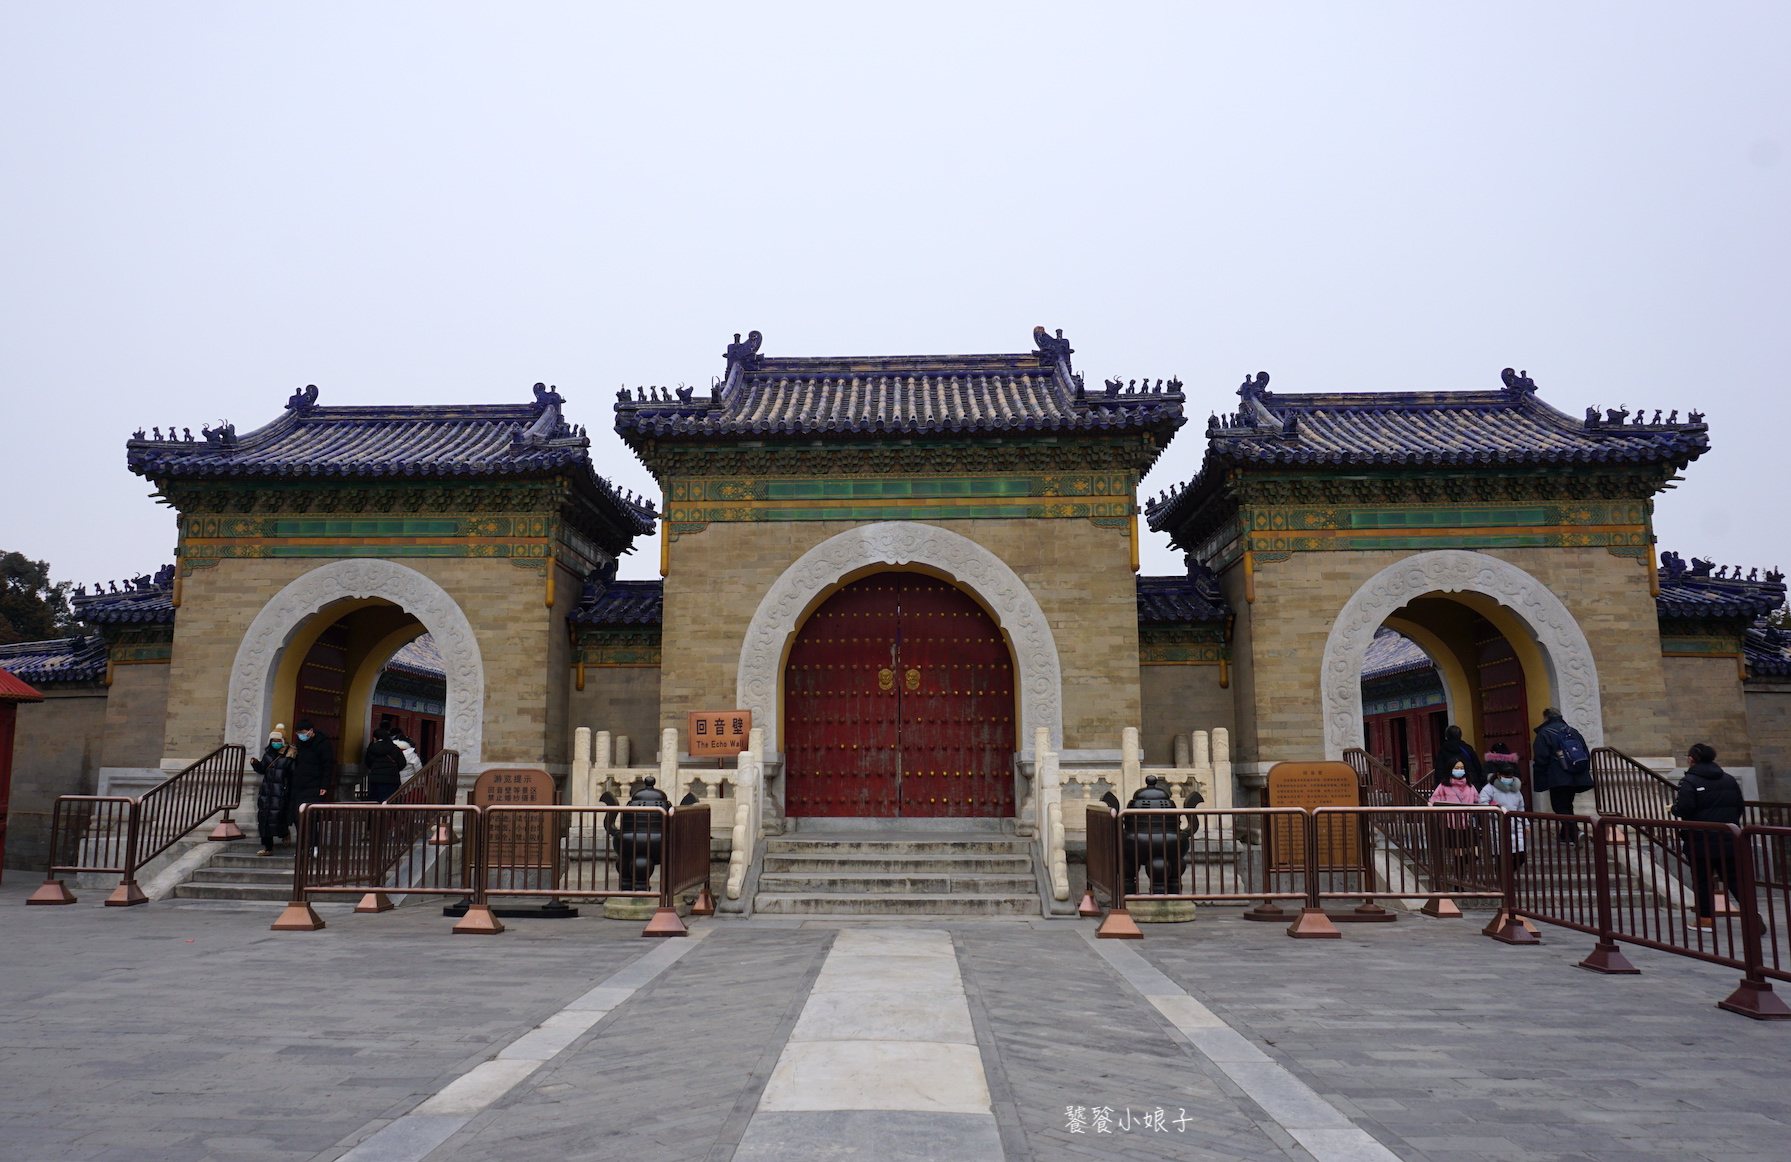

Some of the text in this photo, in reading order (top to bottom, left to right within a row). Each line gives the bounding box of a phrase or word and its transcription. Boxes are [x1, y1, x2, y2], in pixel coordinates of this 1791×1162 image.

[696, 717, 744, 735] 回音壁
[711, 740, 727, 748] Echo
[730, 740, 744, 748] Wall
